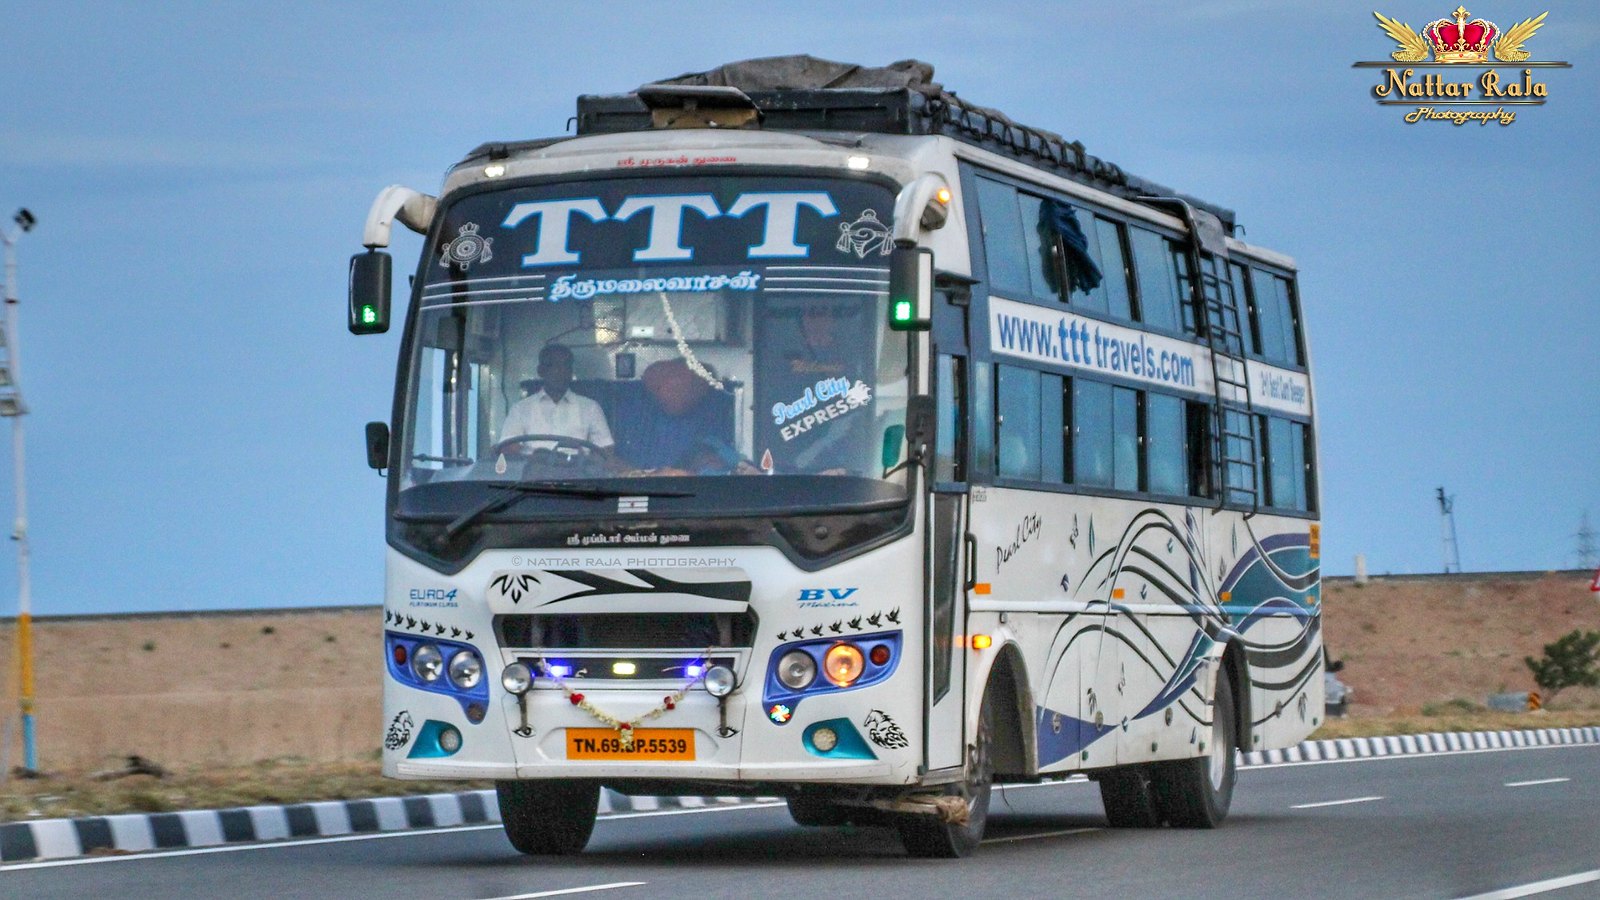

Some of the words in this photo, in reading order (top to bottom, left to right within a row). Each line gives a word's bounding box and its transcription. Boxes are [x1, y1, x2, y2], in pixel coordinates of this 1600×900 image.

[502, 191, 839, 268] TTT
[772, 387, 817, 425] Pearl
[815, 376, 850, 401] City
[780, 398, 860, 441] EXPRESS
[1022, 511, 1042, 543] City
[797, 588, 859, 601] BV
